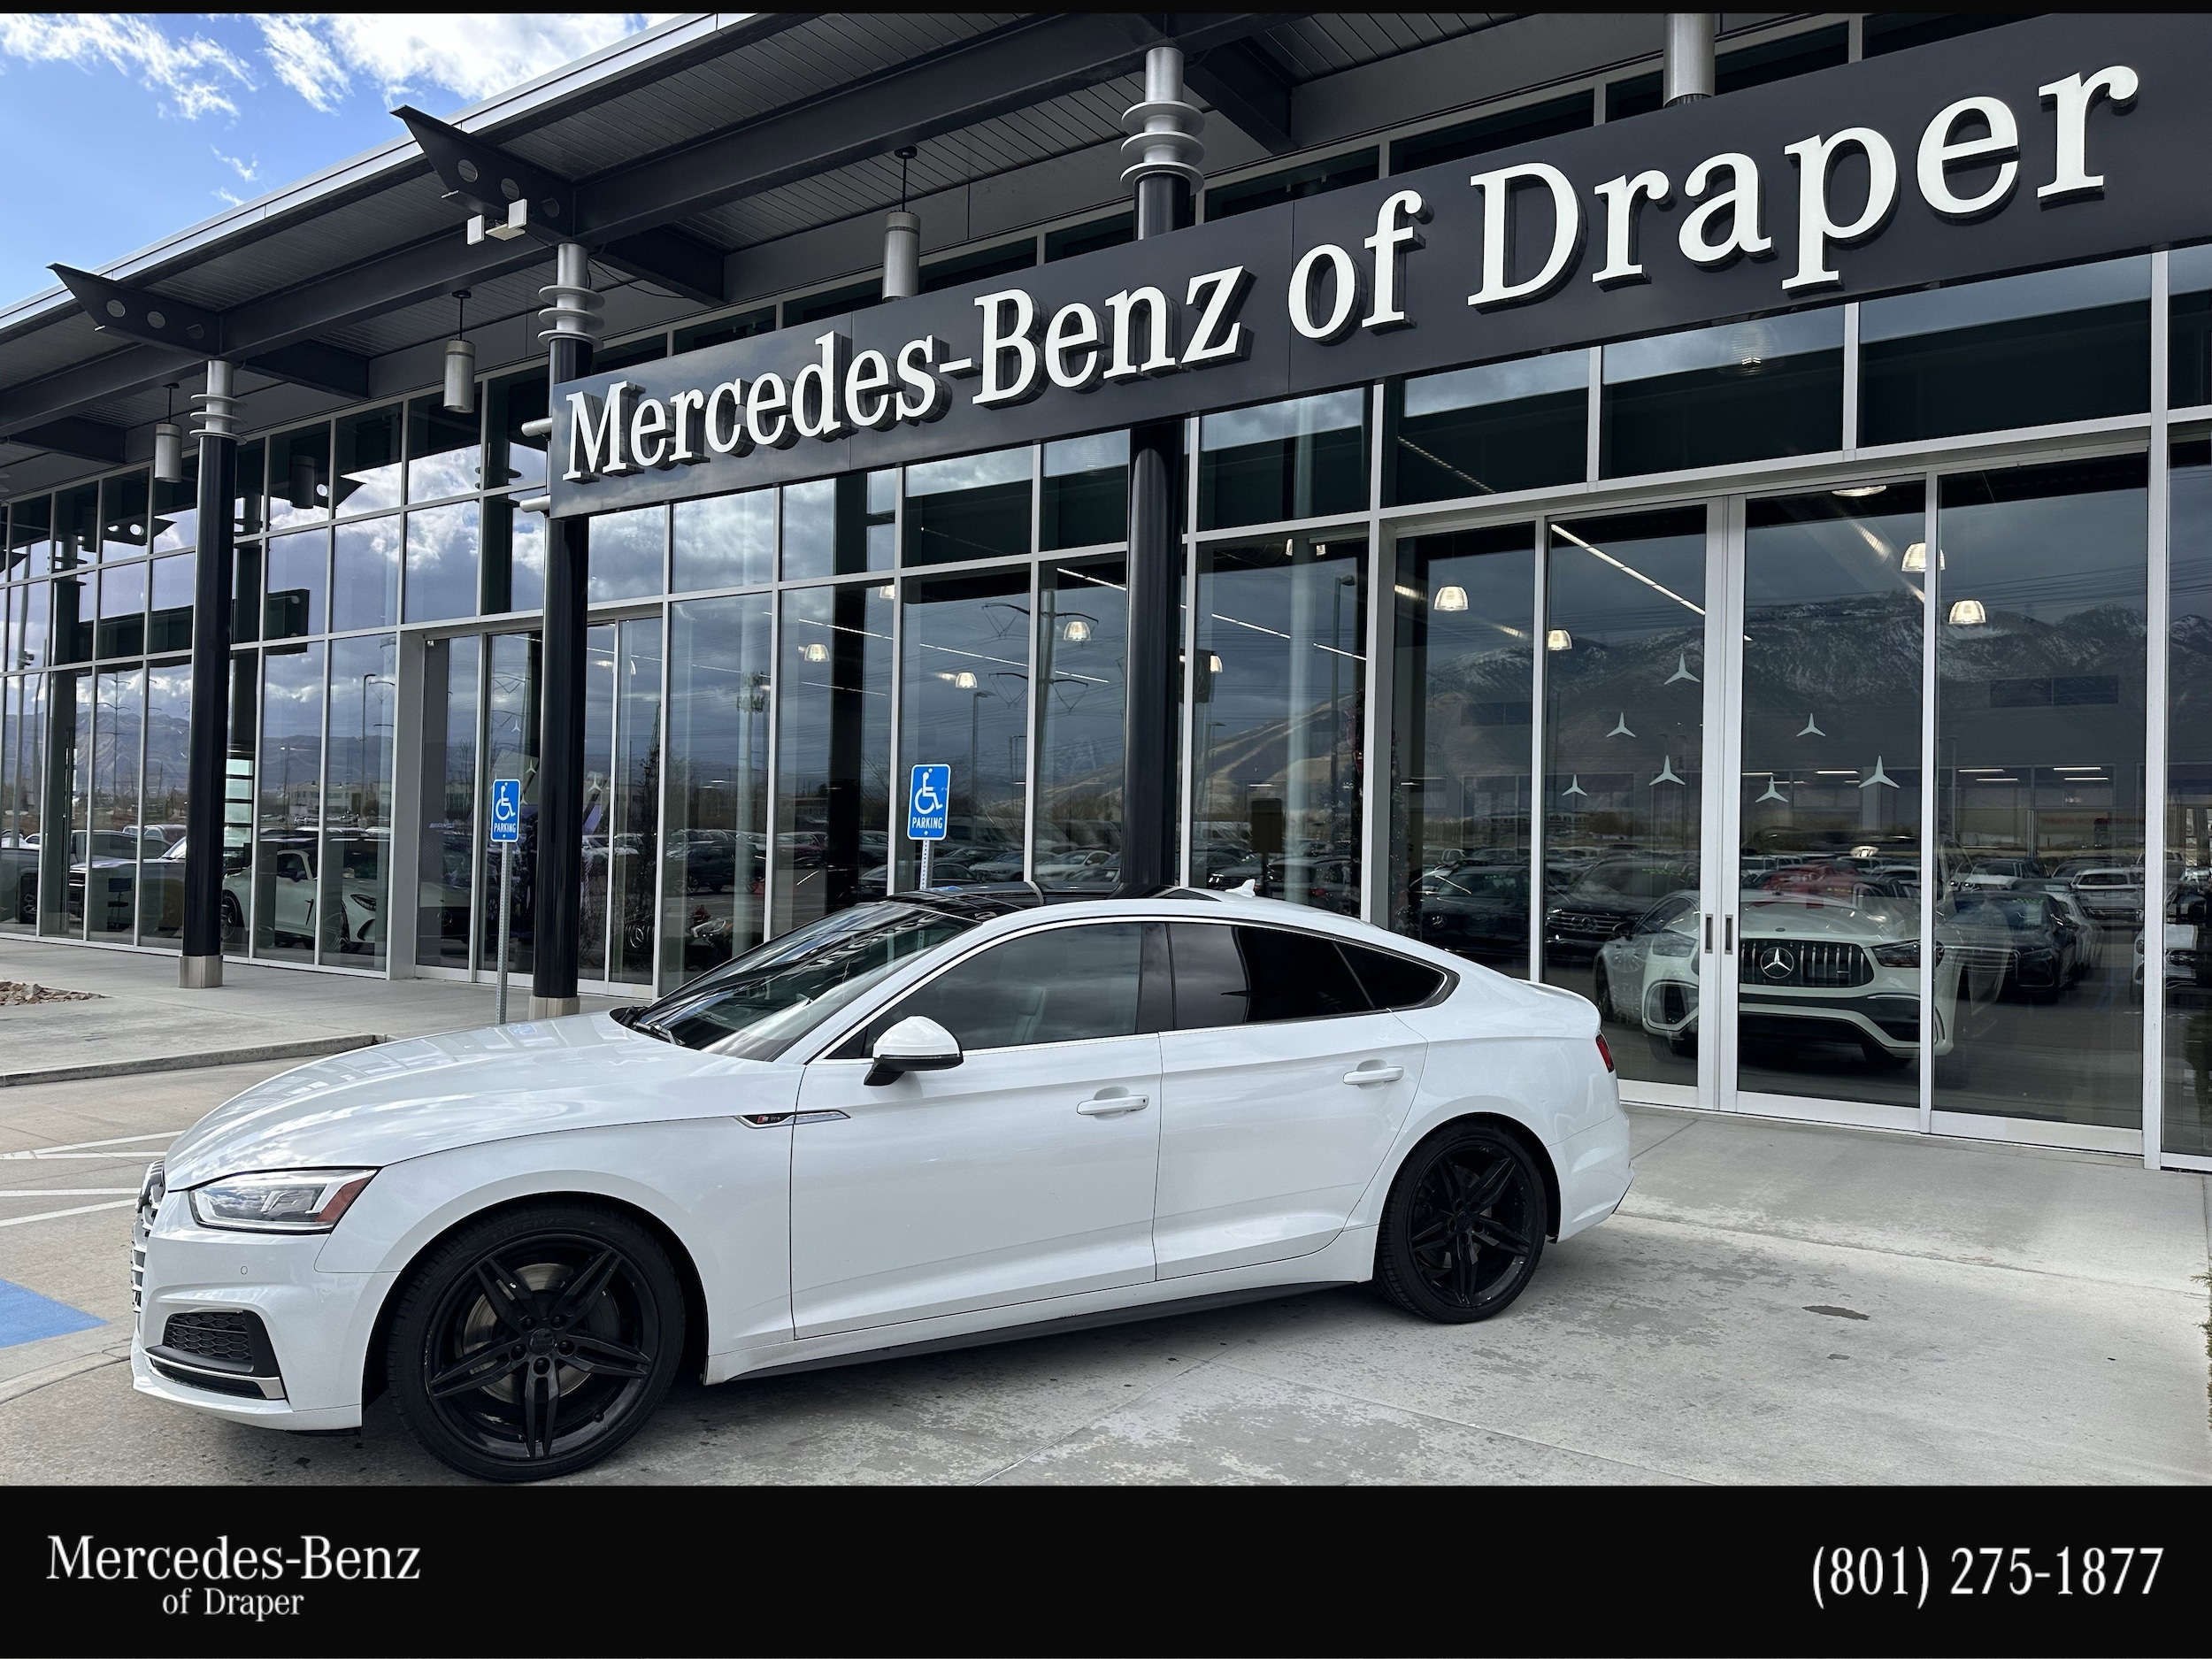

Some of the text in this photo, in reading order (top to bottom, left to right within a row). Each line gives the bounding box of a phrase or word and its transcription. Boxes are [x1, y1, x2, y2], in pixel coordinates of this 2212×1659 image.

[562, 65, 2139, 482] Mercedes-Benz of Draper
[494, 822, 516, 833] PARKING
[911, 816, 943, 830] PARKING
